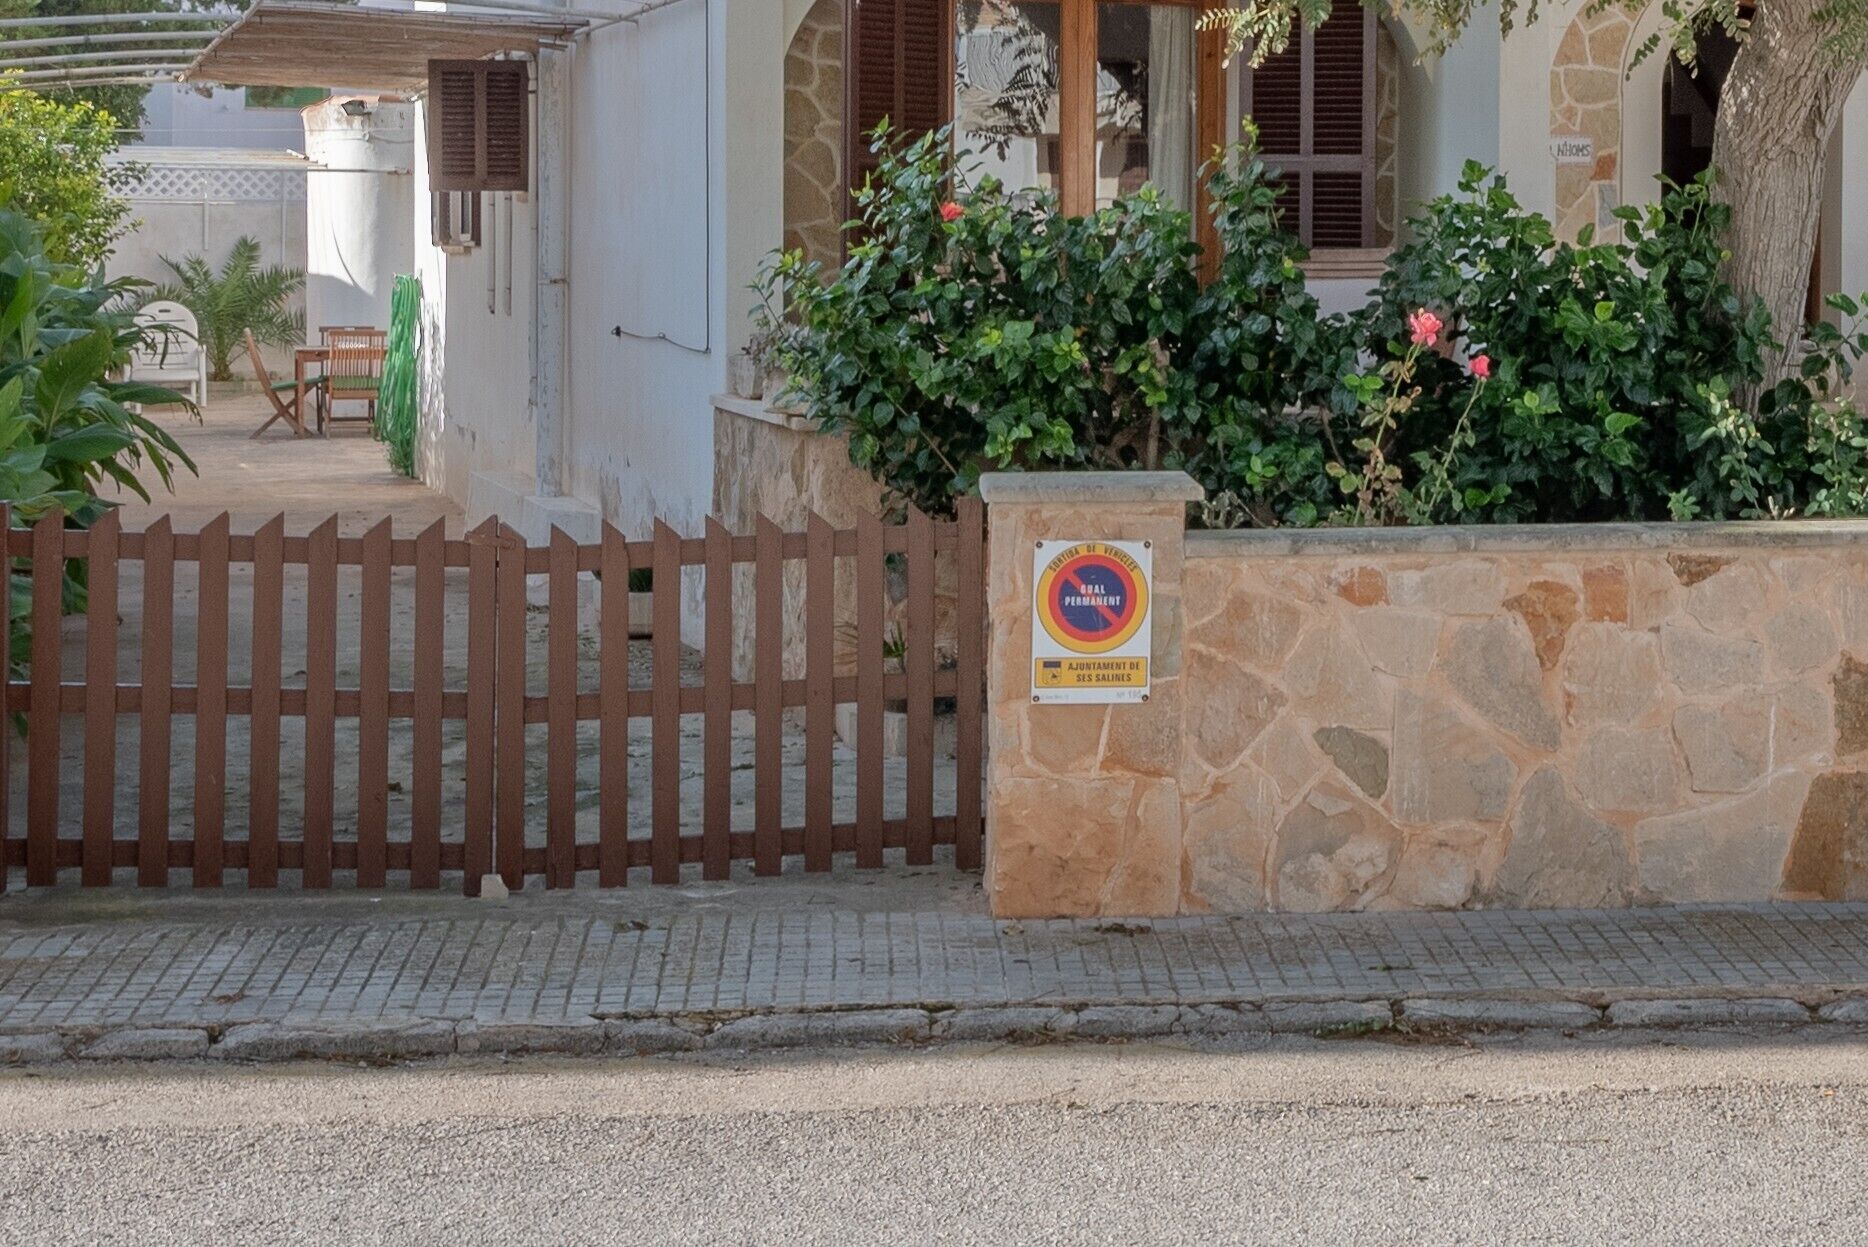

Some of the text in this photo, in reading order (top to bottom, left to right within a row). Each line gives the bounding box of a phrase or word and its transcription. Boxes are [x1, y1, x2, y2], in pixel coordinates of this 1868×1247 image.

[1048, 544, 1138, 573] SORTIDA DE VEHICLES
[1080, 584, 1106, 594] GUAL
[1064, 596, 1121, 607] PERMANENT
[1068, 661, 1140, 671] AJUNTAMENT DE
[1076, 673, 1132, 682] SES SALINES
